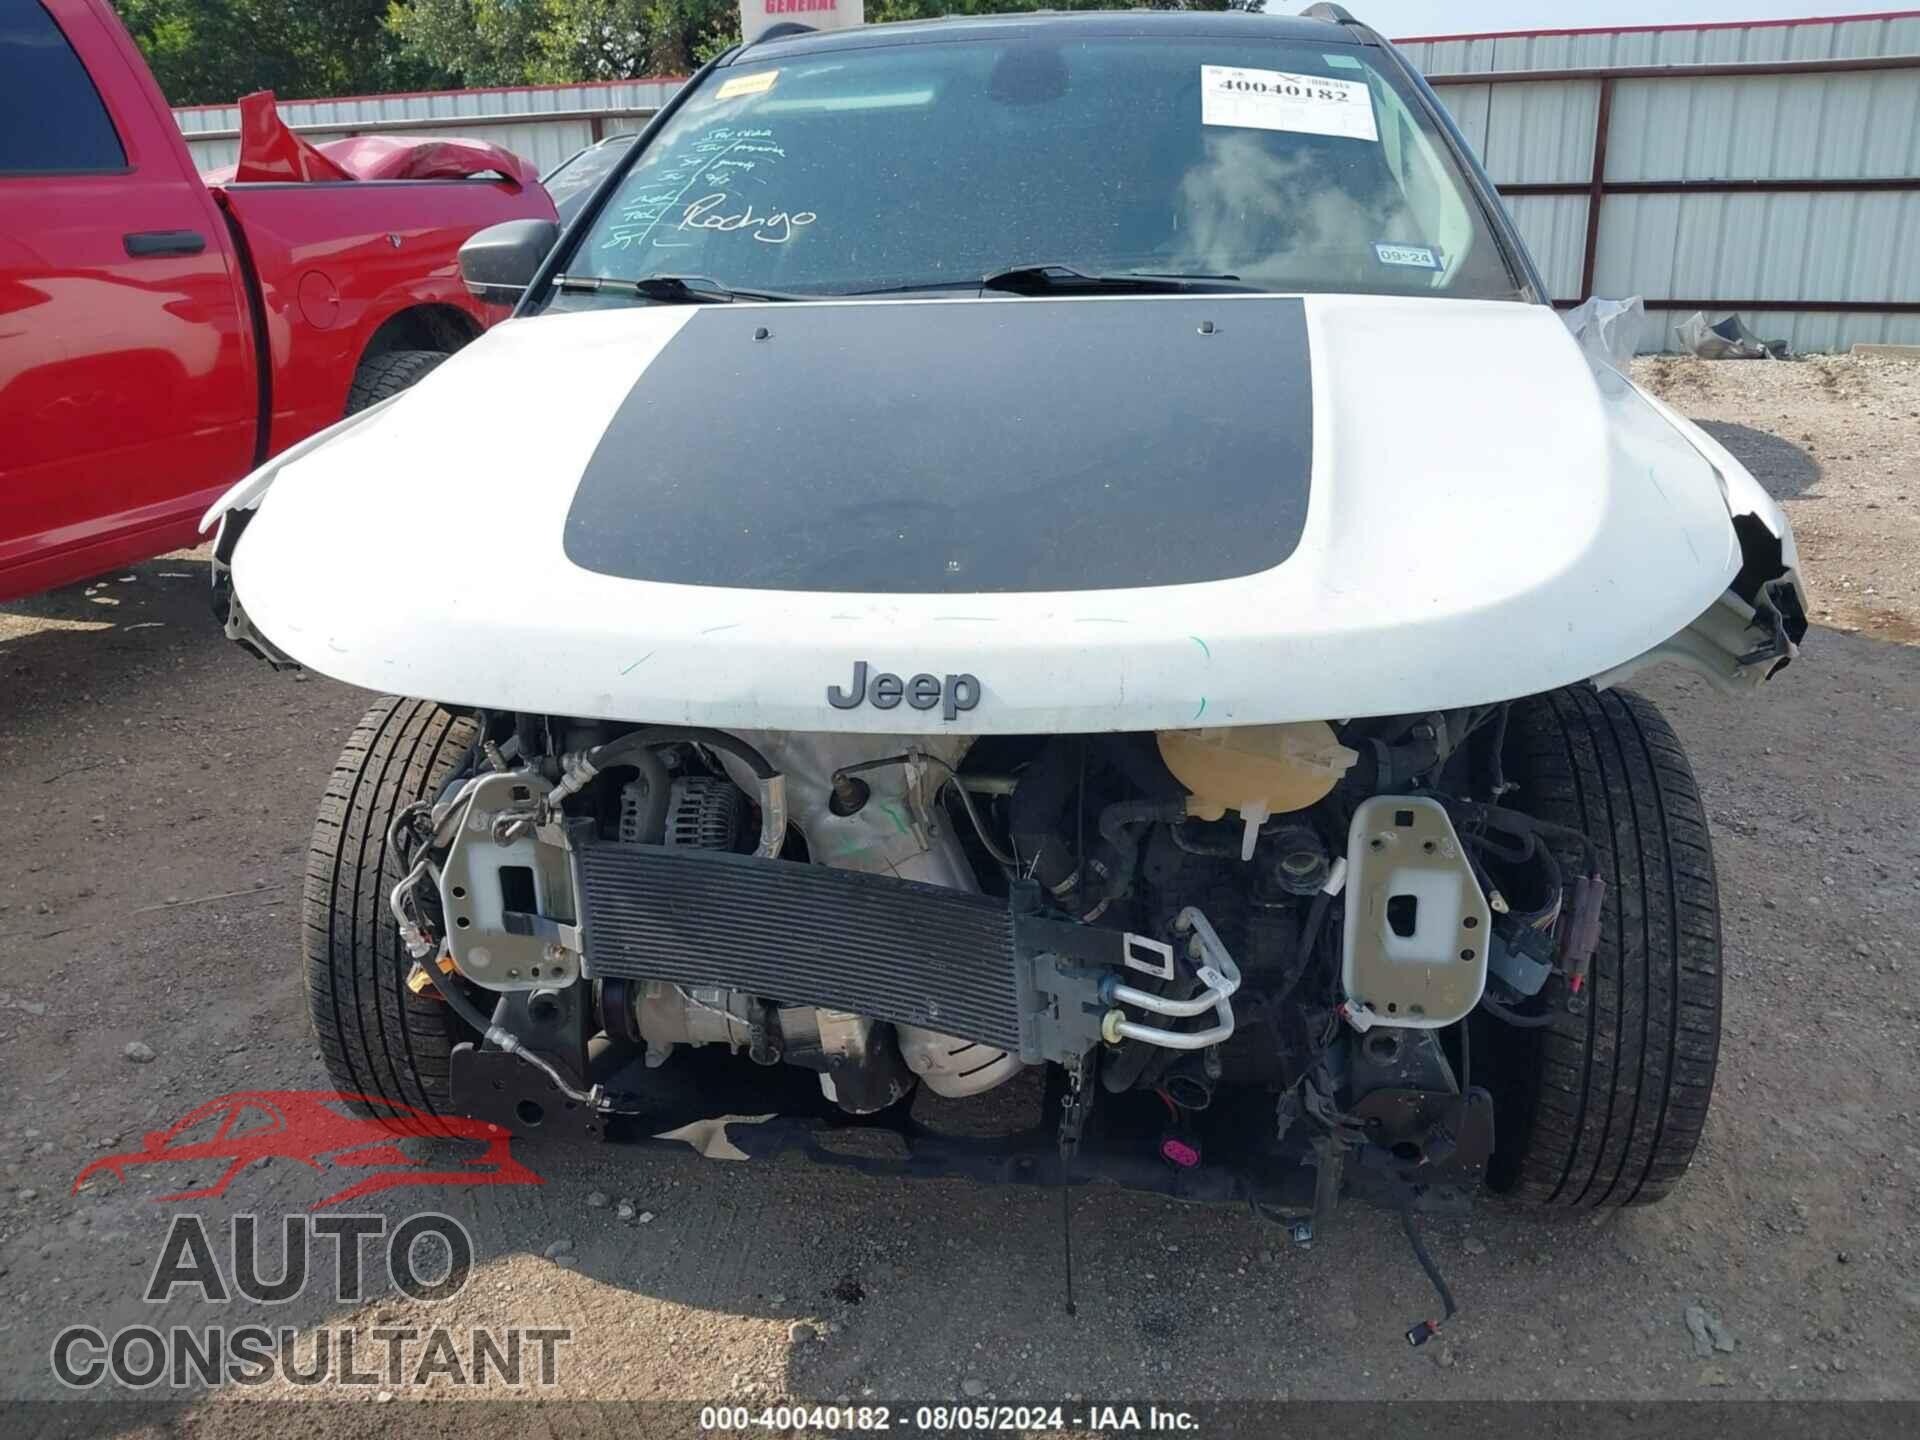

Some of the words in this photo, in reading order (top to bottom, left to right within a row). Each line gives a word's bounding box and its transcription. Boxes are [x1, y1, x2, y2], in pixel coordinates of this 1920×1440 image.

[765, 0, 837, 13] GENERAL
[1219, 80, 1350, 102] 40040182
[827, 660, 982, 721] Jeep
